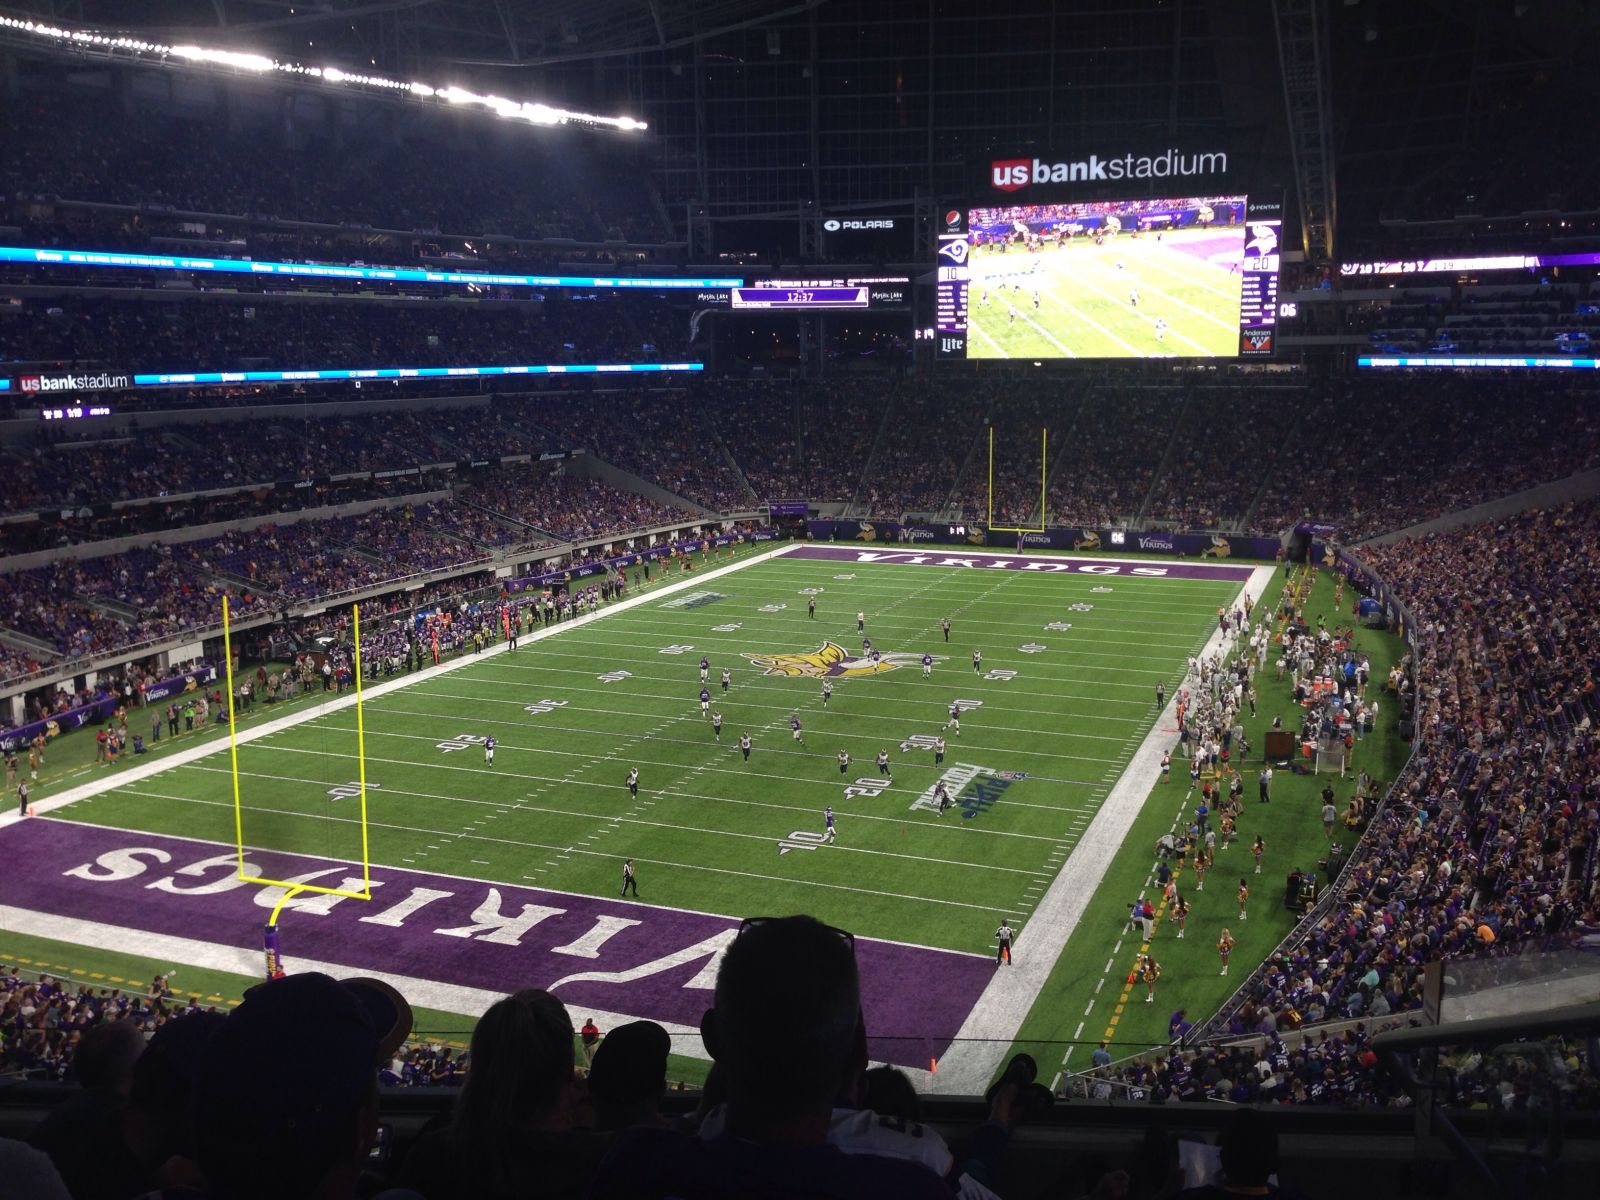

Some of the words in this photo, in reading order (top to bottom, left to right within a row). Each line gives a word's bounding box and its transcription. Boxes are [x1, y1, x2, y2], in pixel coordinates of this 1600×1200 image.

[843, 220, 893, 229] POLARIS
[1253, 257, 1269, 270] 20
[947, 268, 957, 279] 10
[787, 293, 813, 301] 12:37
[1280, 304, 1296, 316] 06
[942, 338, 963, 352] Lite
[902, 527, 934, 540] VKINGS
[1111, 531, 1124, 544] 06
[524, 699, 568, 714] 30
[436, 734, 486, 752] 20
[900, 734, 941, 750] 30
[327, 781, 381, 798] 10
[844, 777, 893, 798] 20
[777, 830, 832, 851] 10
